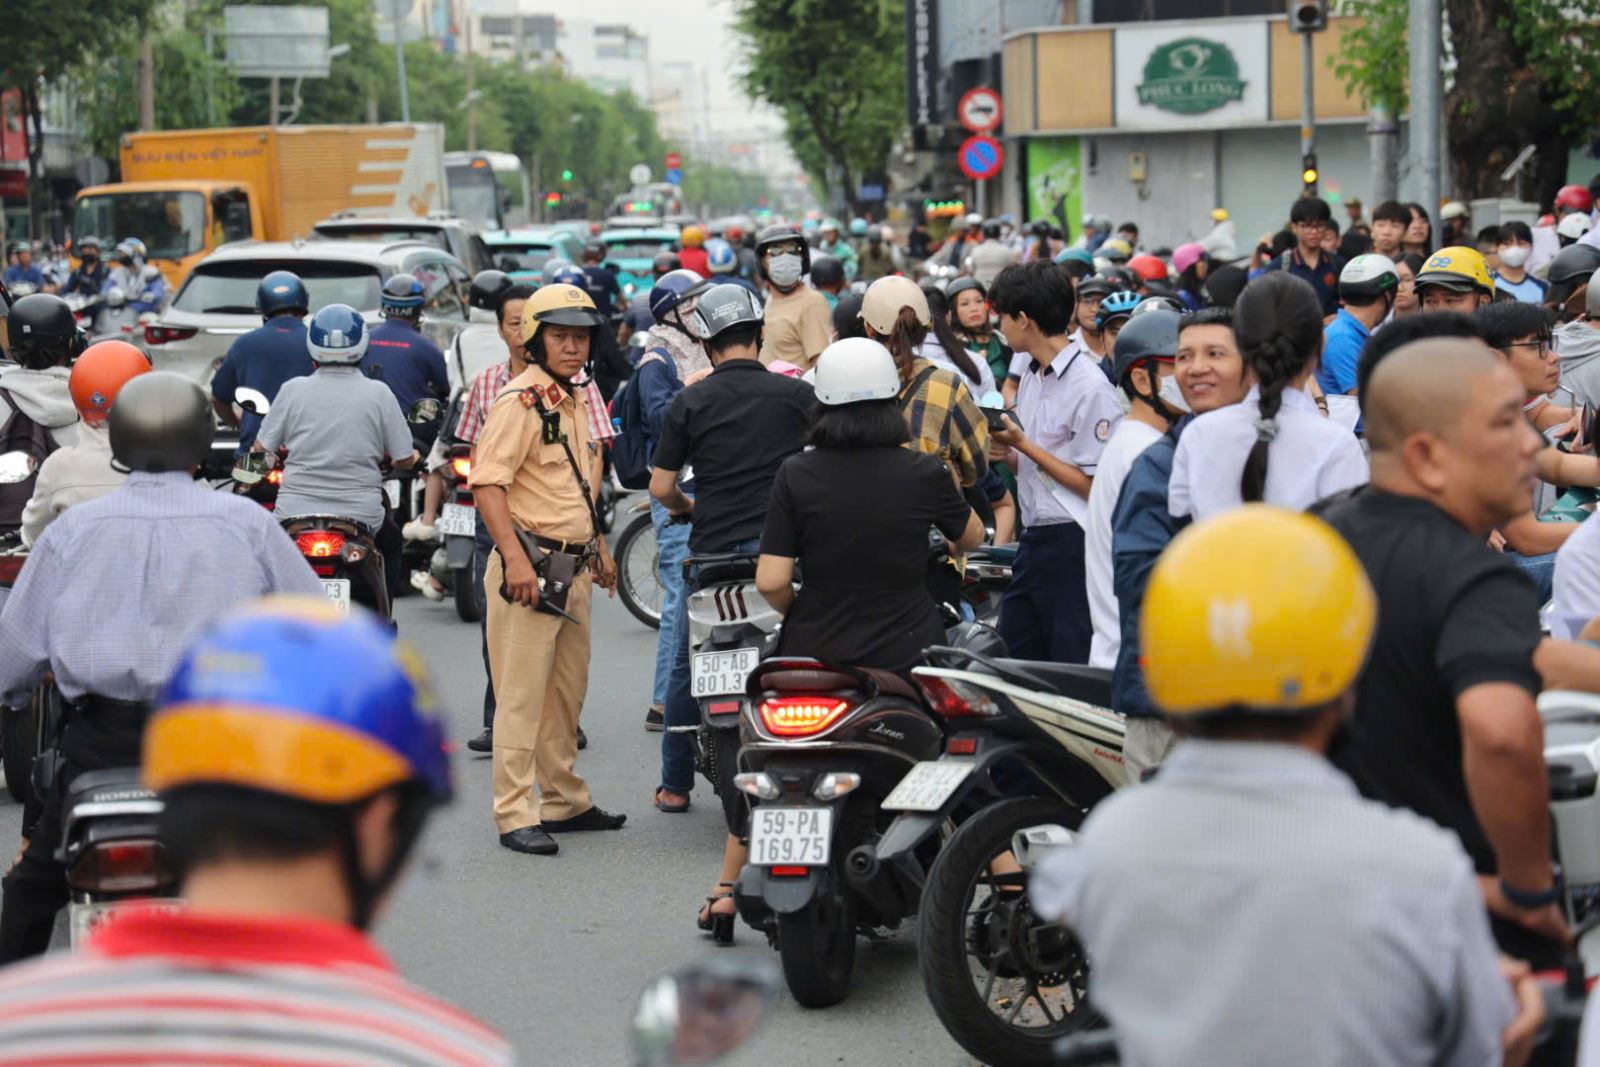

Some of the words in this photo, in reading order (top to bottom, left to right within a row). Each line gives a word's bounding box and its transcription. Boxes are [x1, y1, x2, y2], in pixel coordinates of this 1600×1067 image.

[450, 506, 475, 520] 59-U
[702, 653, 748, 673] 50-AB
[94, 790, 157, 801] HONDA
[763, 811, 819, 834] 59-PA
[758, 837, 824, 861] 169.75
